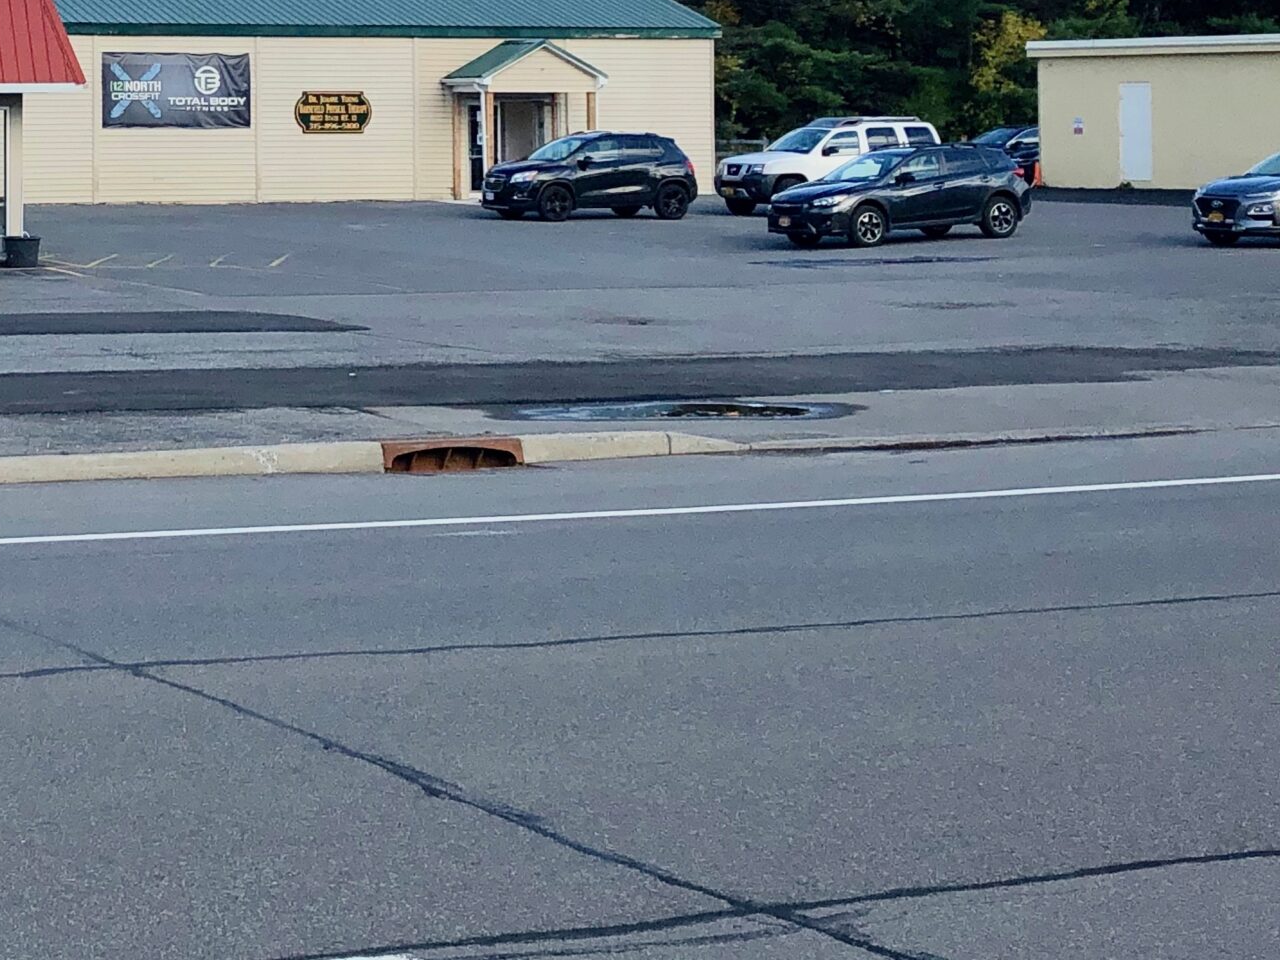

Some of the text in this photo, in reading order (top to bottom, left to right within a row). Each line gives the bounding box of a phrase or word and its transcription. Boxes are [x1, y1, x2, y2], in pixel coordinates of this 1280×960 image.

[111, 92, 160, 101] CROSSFIT
[168, 97, 247, 106] TOTAL BODY
